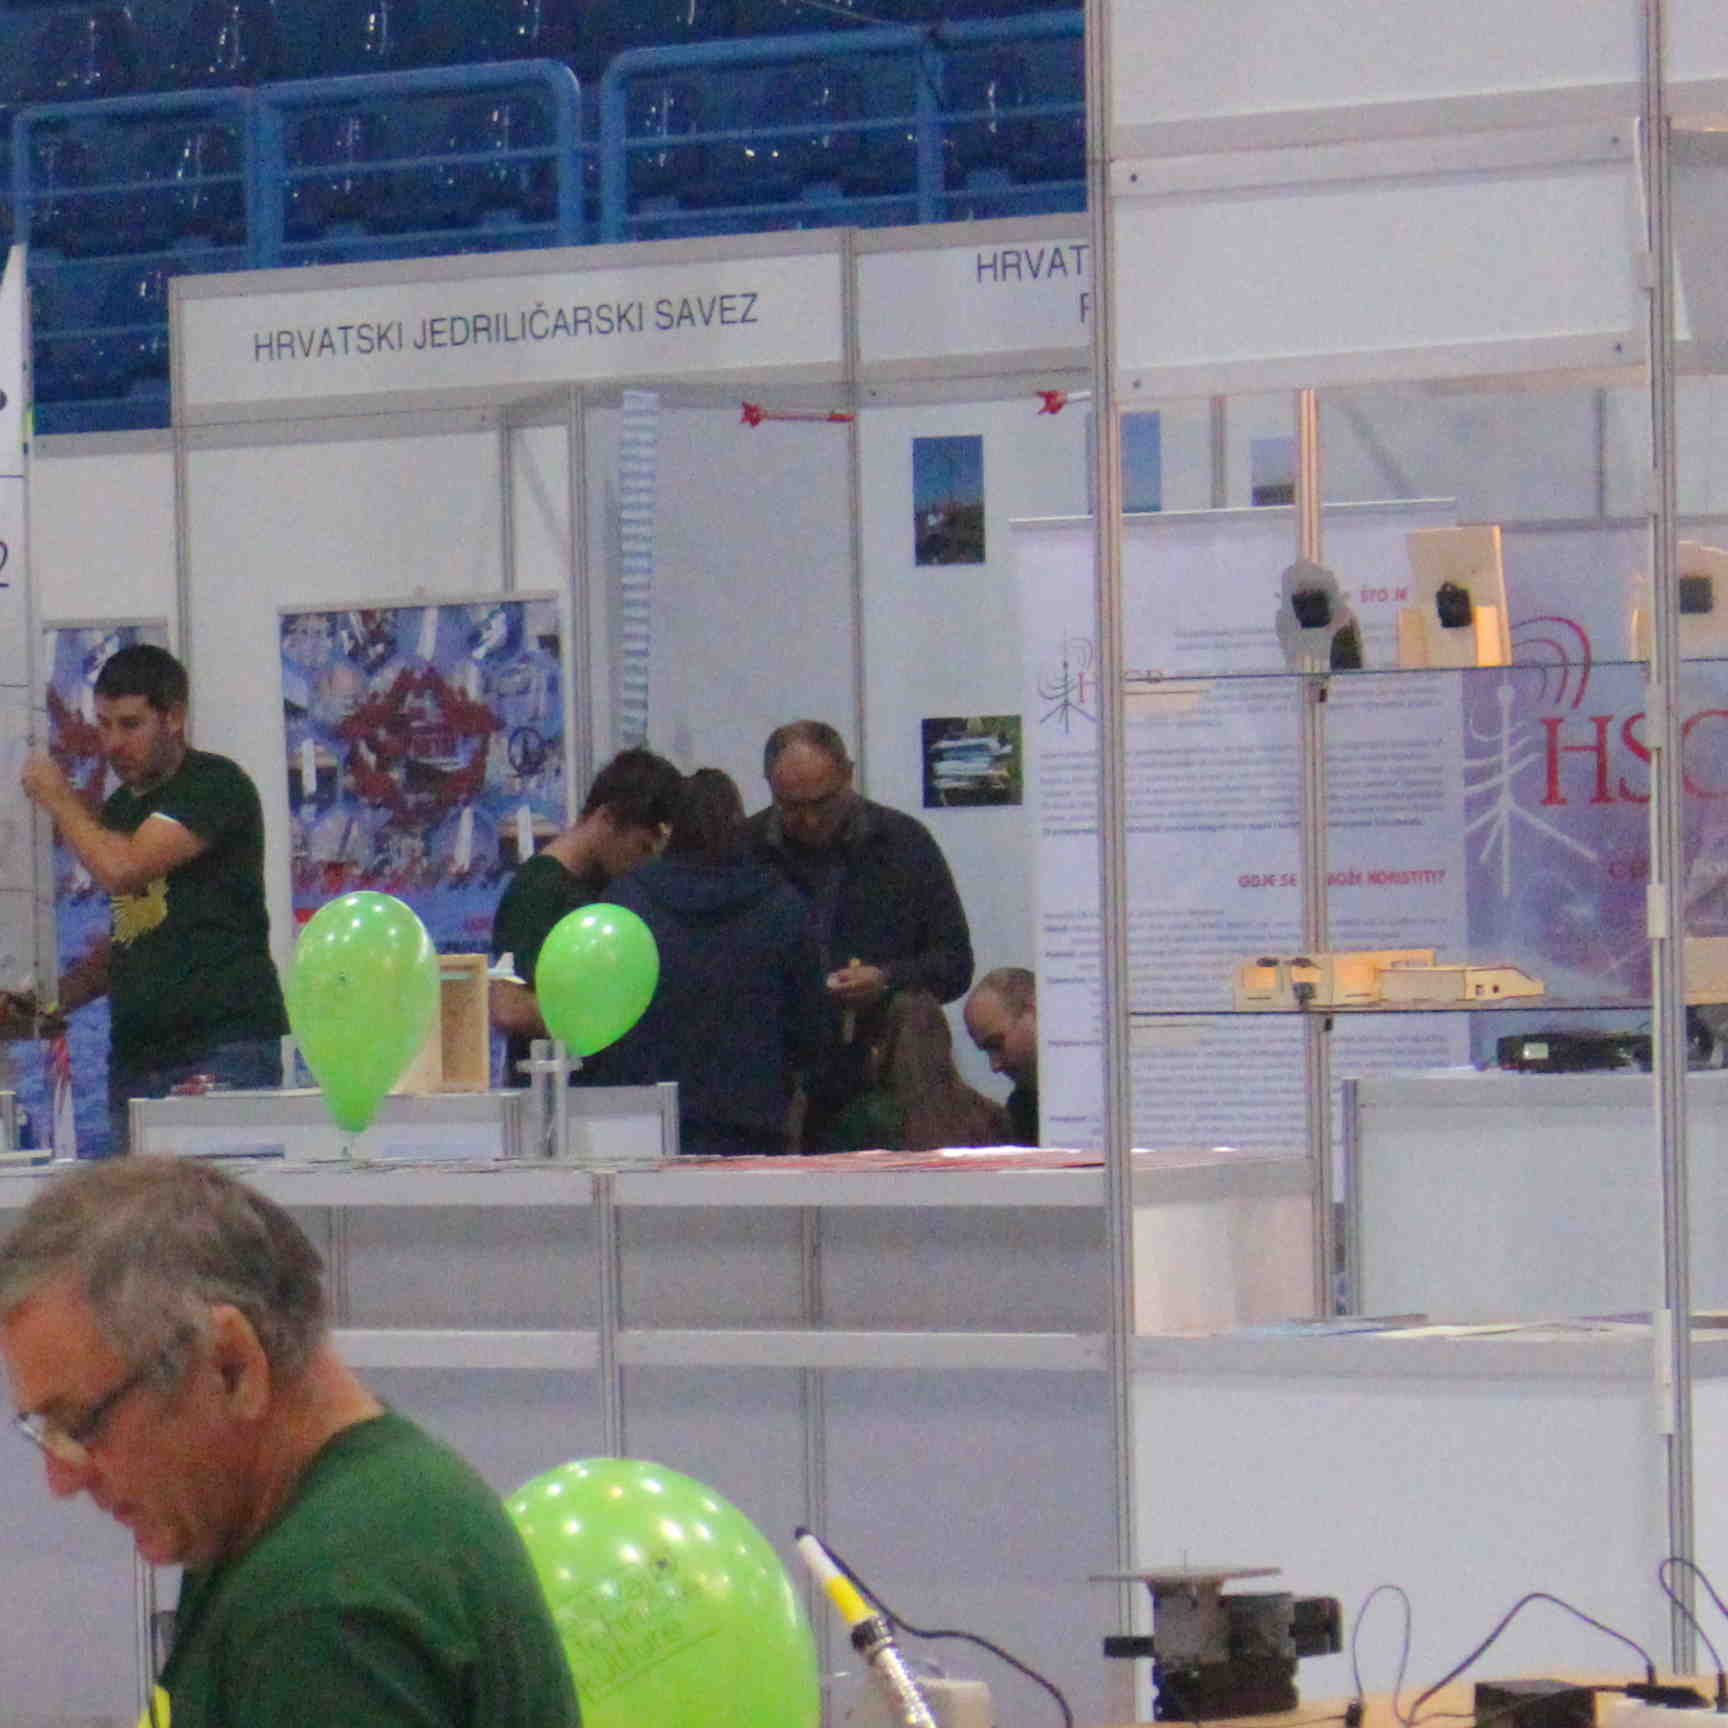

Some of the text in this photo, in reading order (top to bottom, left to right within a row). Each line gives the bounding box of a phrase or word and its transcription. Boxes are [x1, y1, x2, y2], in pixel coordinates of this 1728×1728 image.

[976, 244, 1090, 284] HRVAT
[253, 291, 759, 364] HRVATSKI JEDRILIČARSKI SAVEZ
